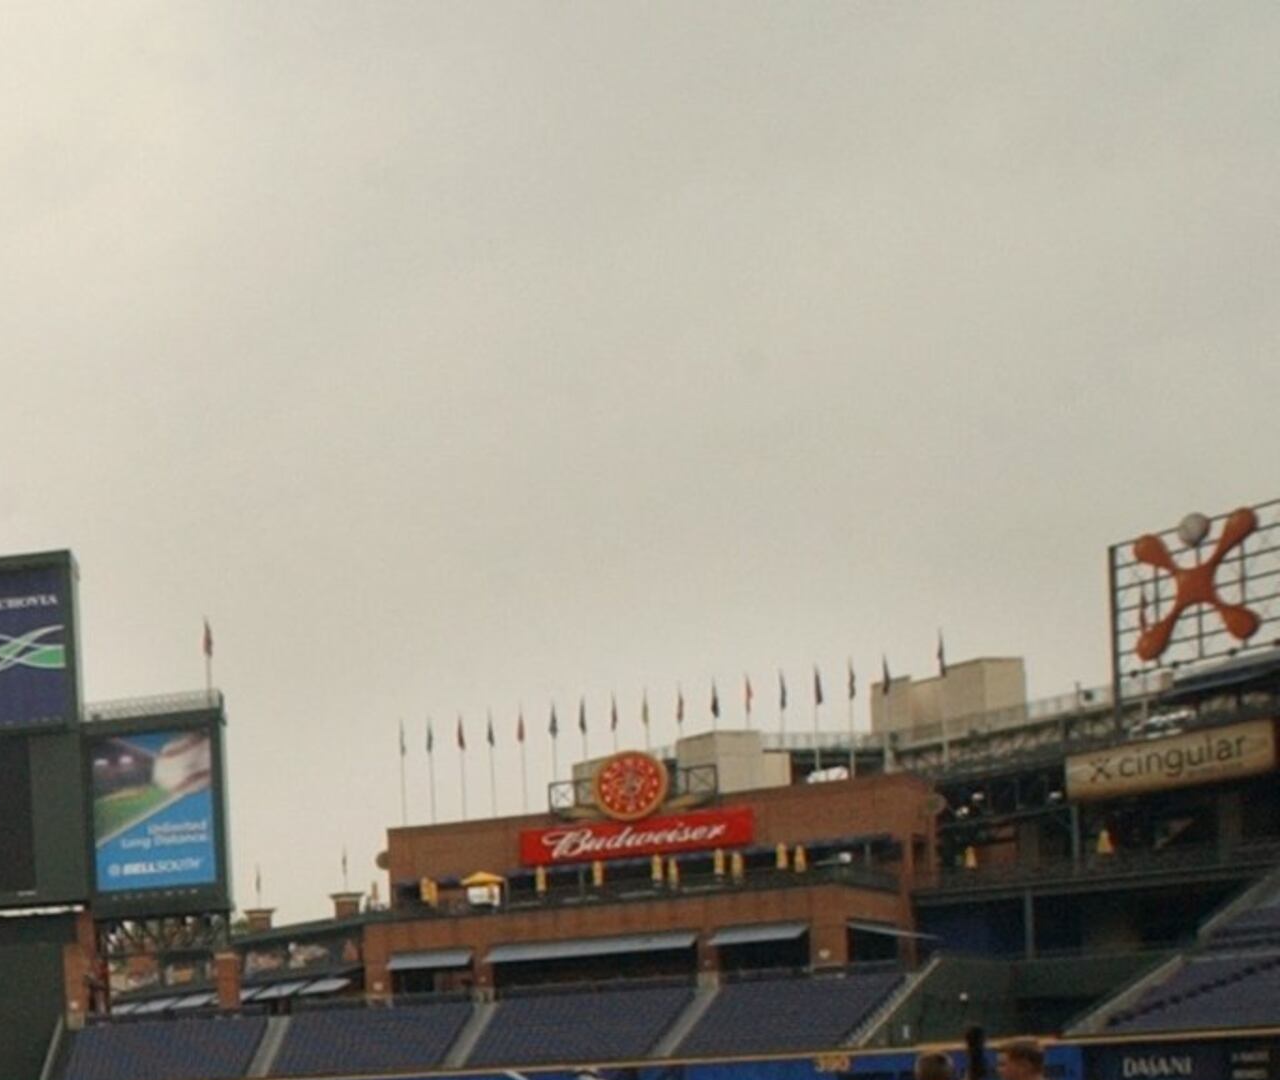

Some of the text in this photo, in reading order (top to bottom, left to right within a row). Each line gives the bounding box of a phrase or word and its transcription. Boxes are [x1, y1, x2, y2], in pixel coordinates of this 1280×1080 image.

[1118, 735, 1244, 778] cingular
[542, 823, 727, 859] Budweiser
[1122, 1055, 1192, 1079] DASANI
